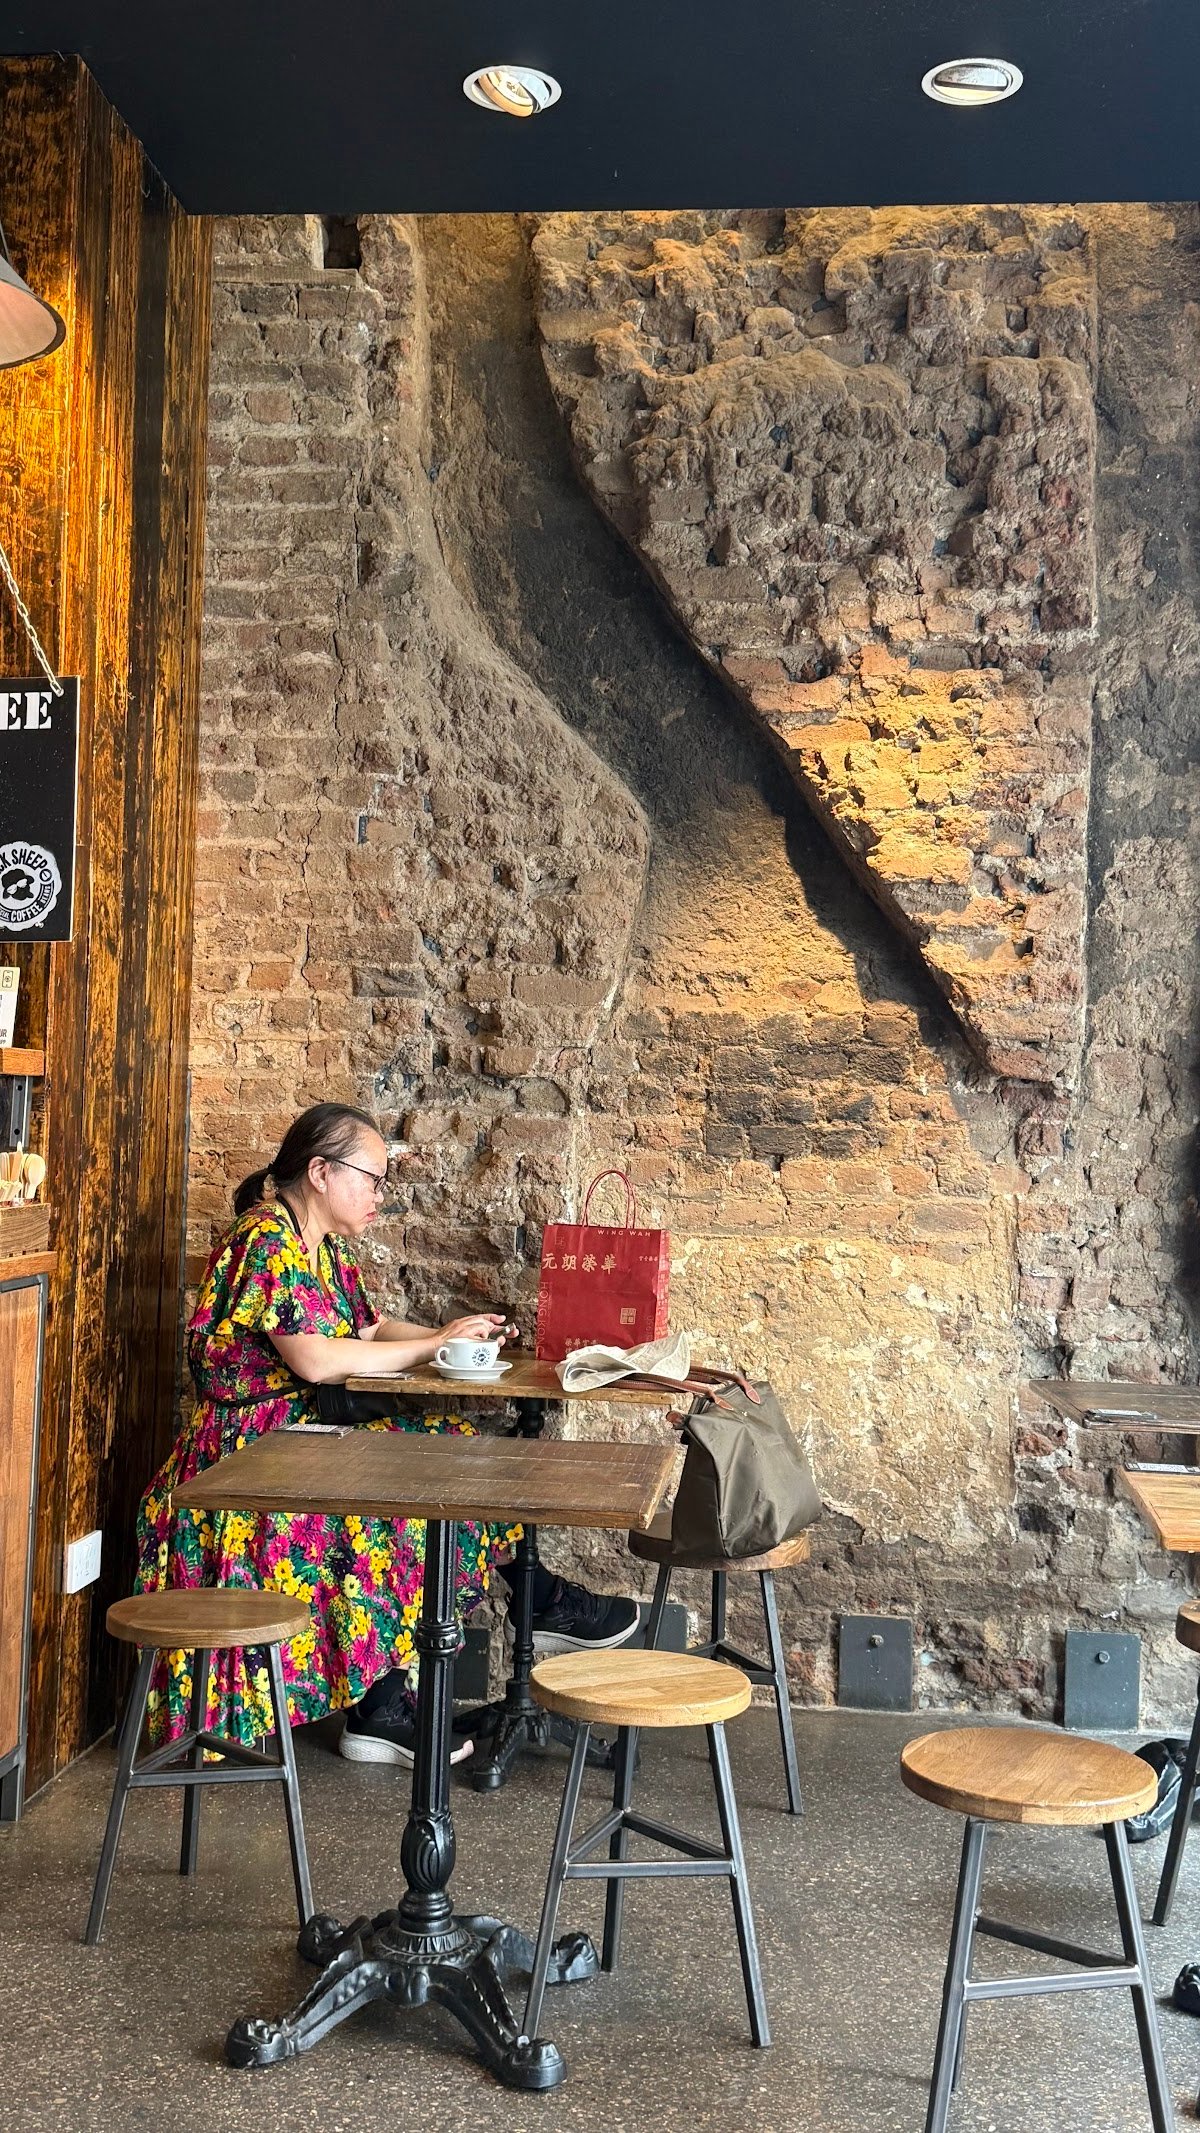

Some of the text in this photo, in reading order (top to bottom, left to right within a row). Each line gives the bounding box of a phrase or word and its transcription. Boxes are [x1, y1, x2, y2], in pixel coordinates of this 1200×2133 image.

[11, 848, 47, 871] SHEEP
[11, 902, 43, 921] COFFEE
[541, 1252, 617, 1275] 元朗榮華
[539, 1281, 549, 1317] HONG
